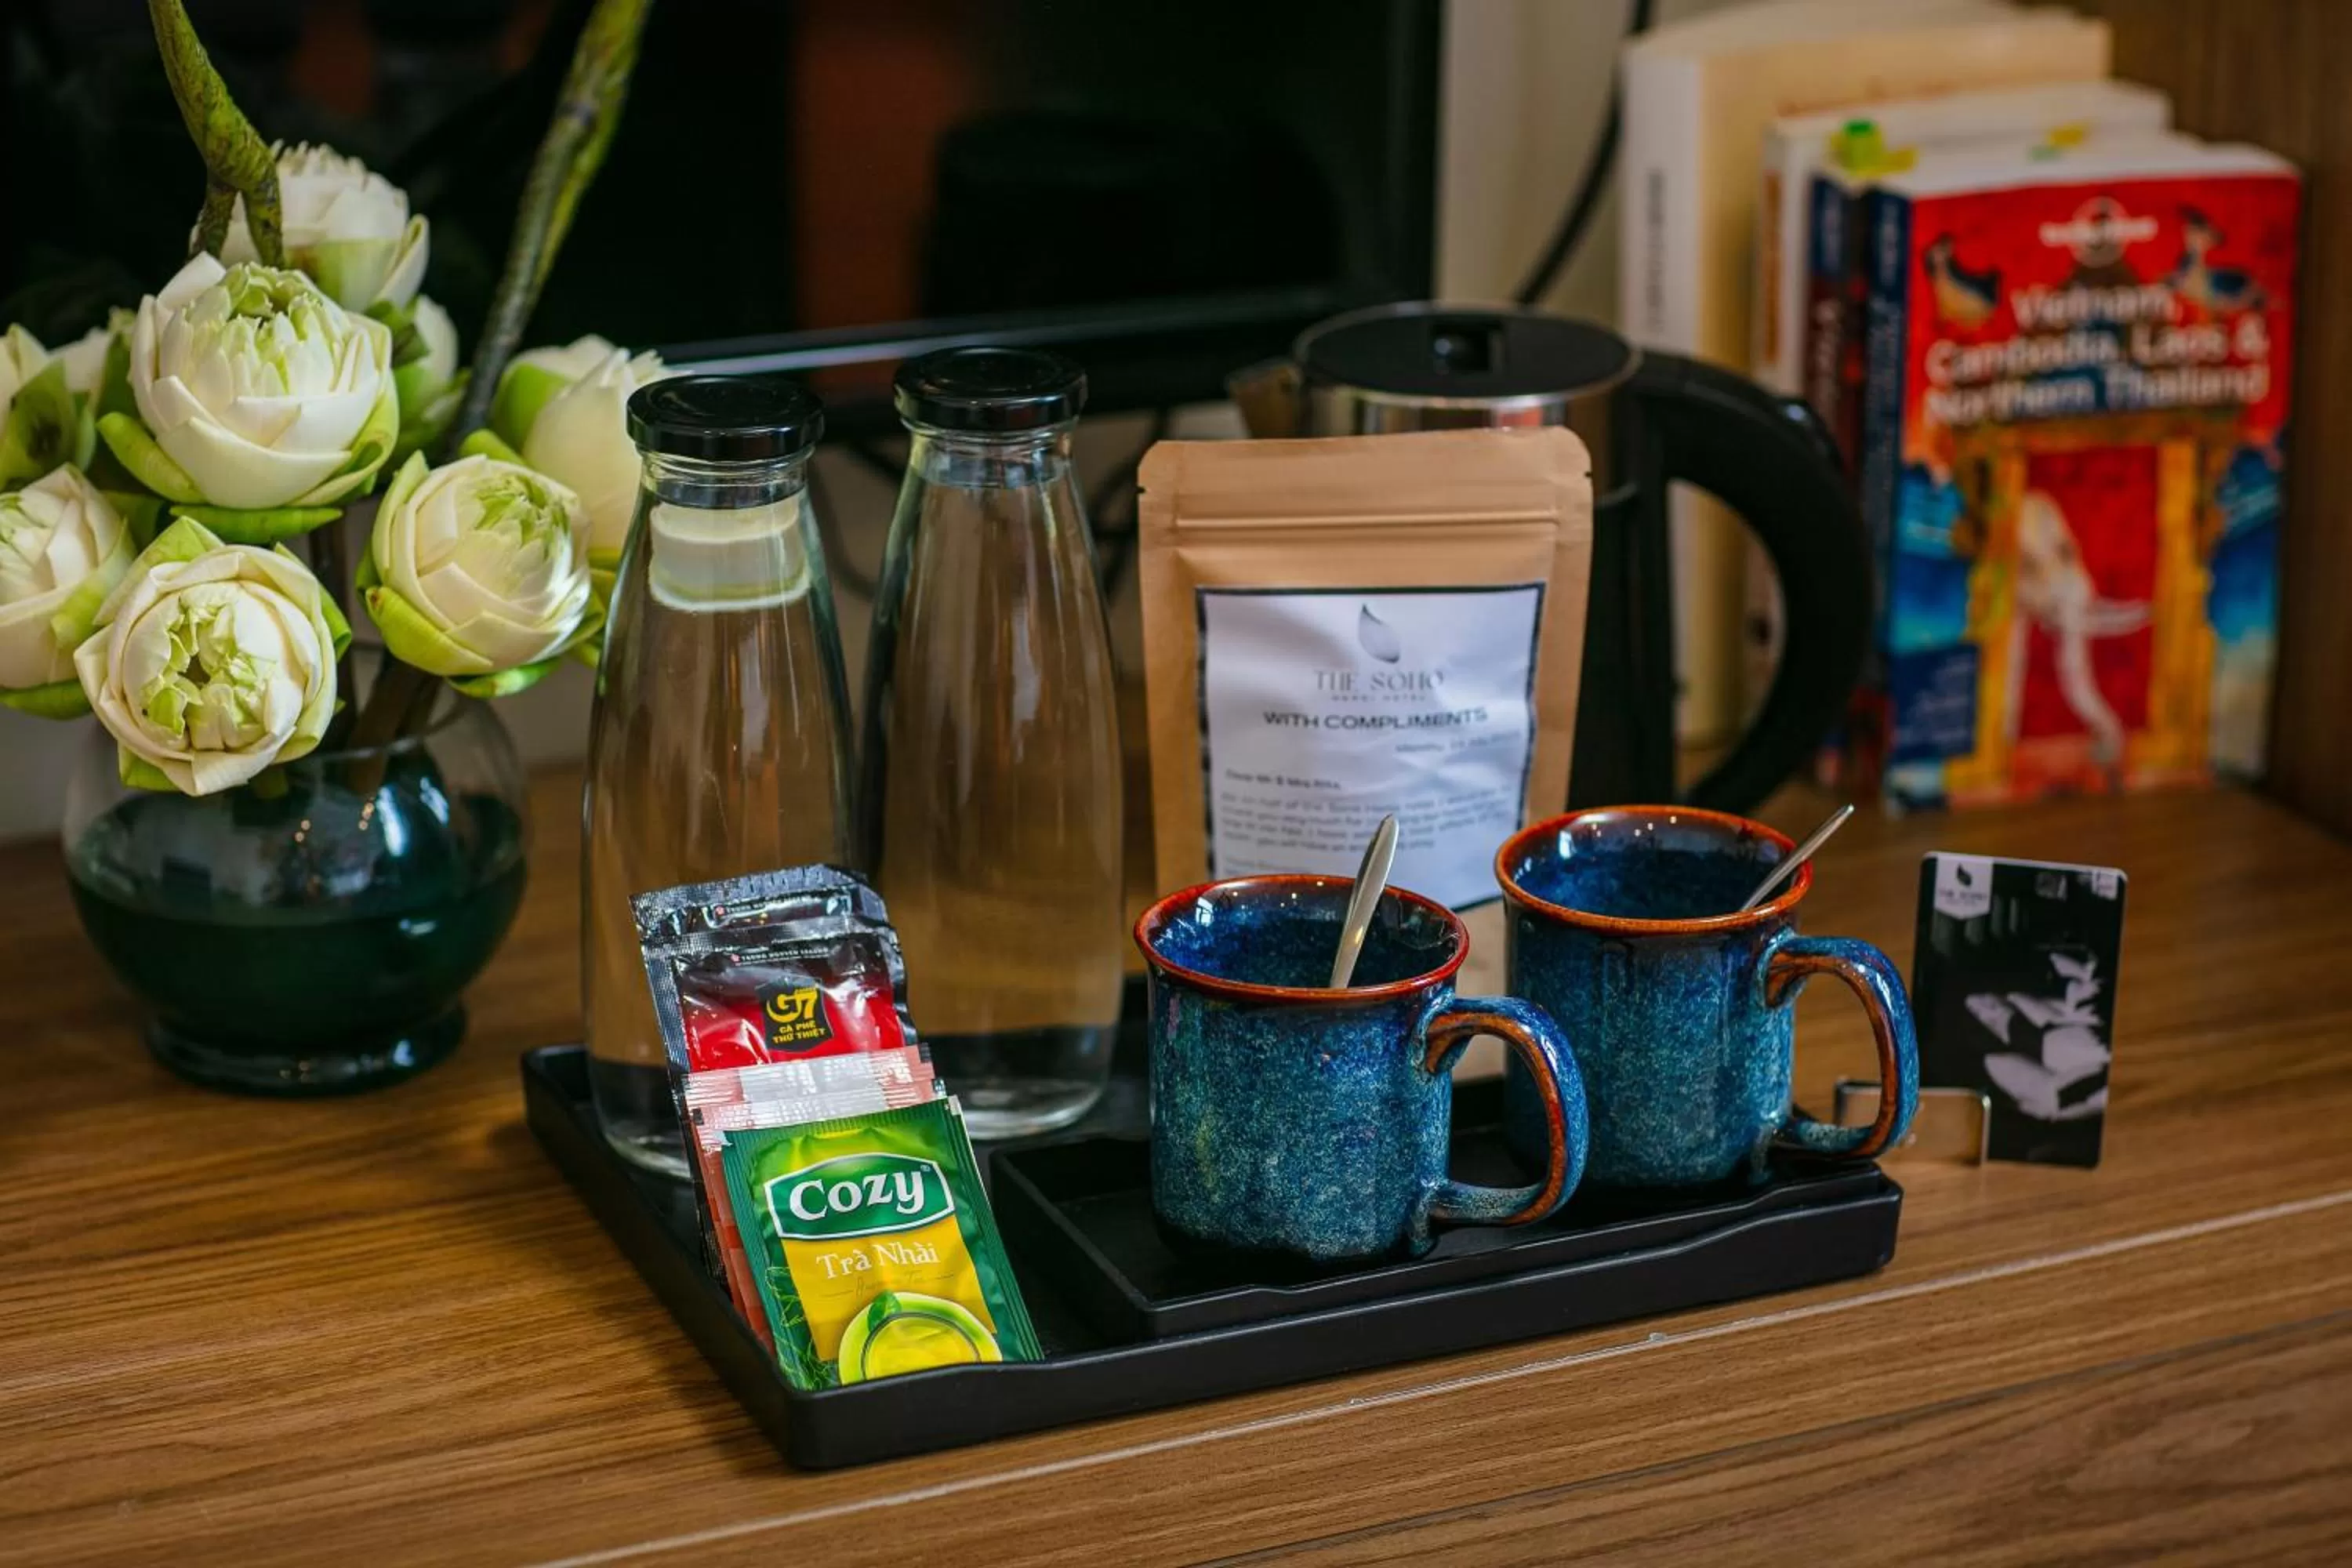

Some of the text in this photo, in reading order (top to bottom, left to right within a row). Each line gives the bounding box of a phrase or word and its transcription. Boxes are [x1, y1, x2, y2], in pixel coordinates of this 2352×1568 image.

[1316, 669, 1445, 691] THE SOHO
[1263, 706, 1488, 730] WITH COMPLIMENTS
[766, 989, 818, 1023] G7
[789, 1171, 925, 1221] Cozy
[815, 1241, 942, 1279] Trà Nhài
